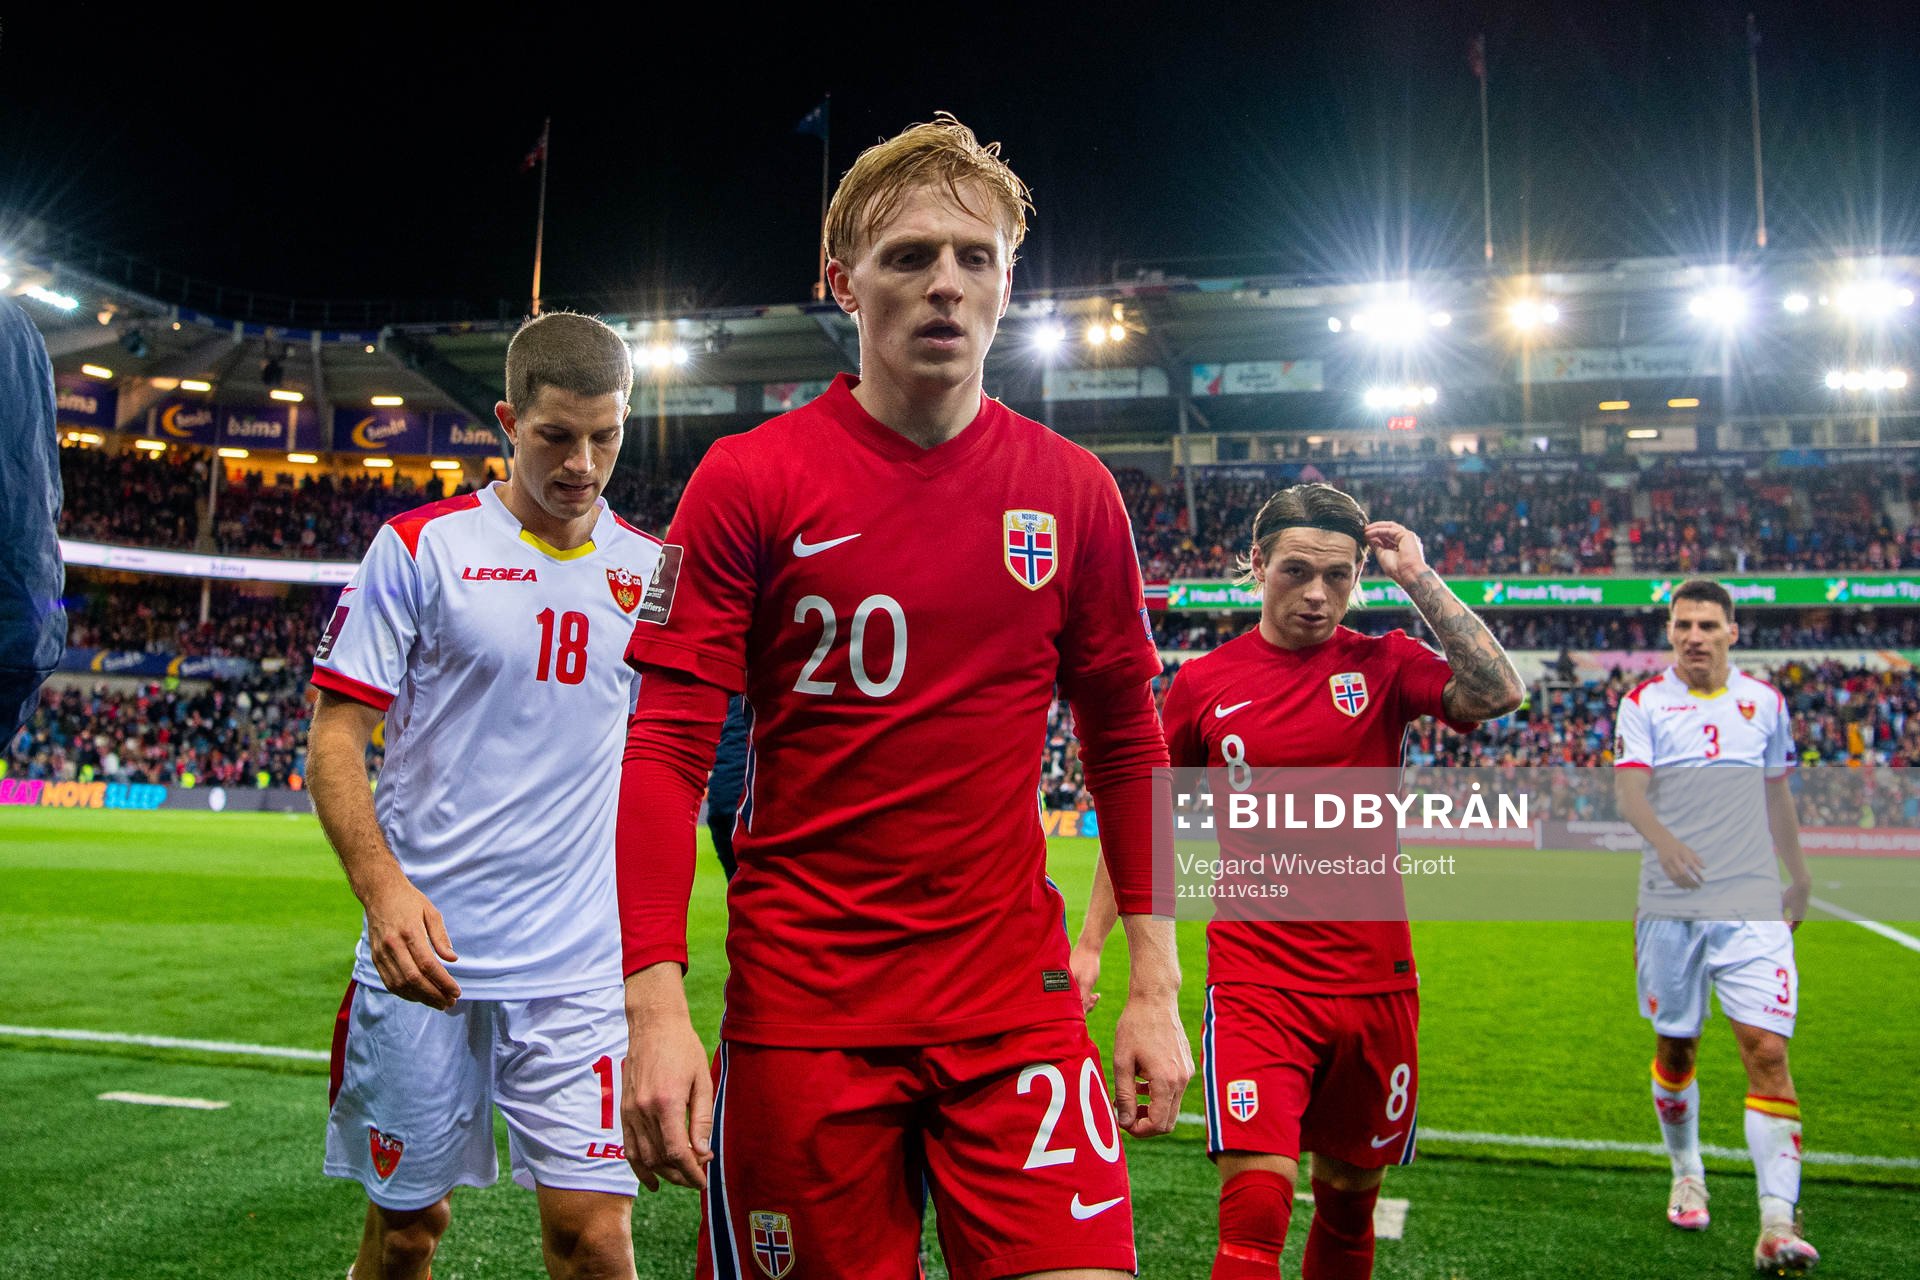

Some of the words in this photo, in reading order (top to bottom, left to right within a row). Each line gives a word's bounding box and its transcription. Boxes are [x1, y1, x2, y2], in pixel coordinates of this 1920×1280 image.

[57, 393, 97, 414] ama
[461, 567, 538, 582] LEGEA
[536, 607, 590, 686] 18
[793, 594, 908, 698] 20
[1703, 724, 1720, 760] 3
[1221, 733, 1253, 792] 8
[41, 780, 107, 809] MOVE
[1042, 810, 1080, 837] VE
[1776, 968, 1790, 1004] 3
[592, 1055, 625, 1129] 1
[1385, 1063, 1411, 1122] 8
[1017, 1056, 1120, 1170] 20
[586, 1142, 626, 1160] LEG
